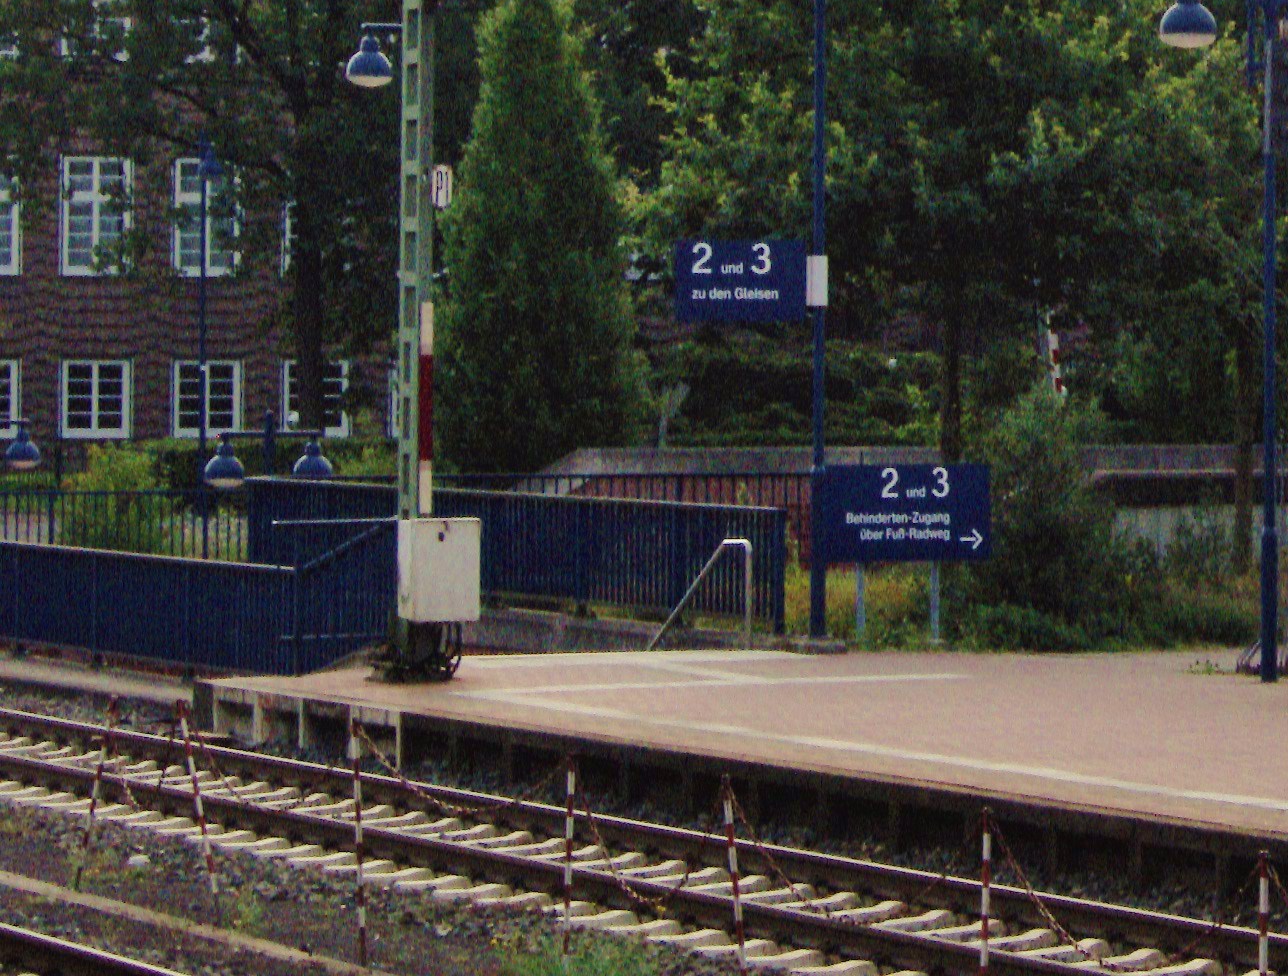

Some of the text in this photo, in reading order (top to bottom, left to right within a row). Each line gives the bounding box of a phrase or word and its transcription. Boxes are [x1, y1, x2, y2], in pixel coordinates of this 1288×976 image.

[691, 242, 771, 274] 2 und 3
[692, 287, 779, 299] zu den Gleisen
[881, 466, 950, 498] 2 und 3
[846, 512, 950, 526] Behinderten-Zugang
[860, 527, 883, 540] über
